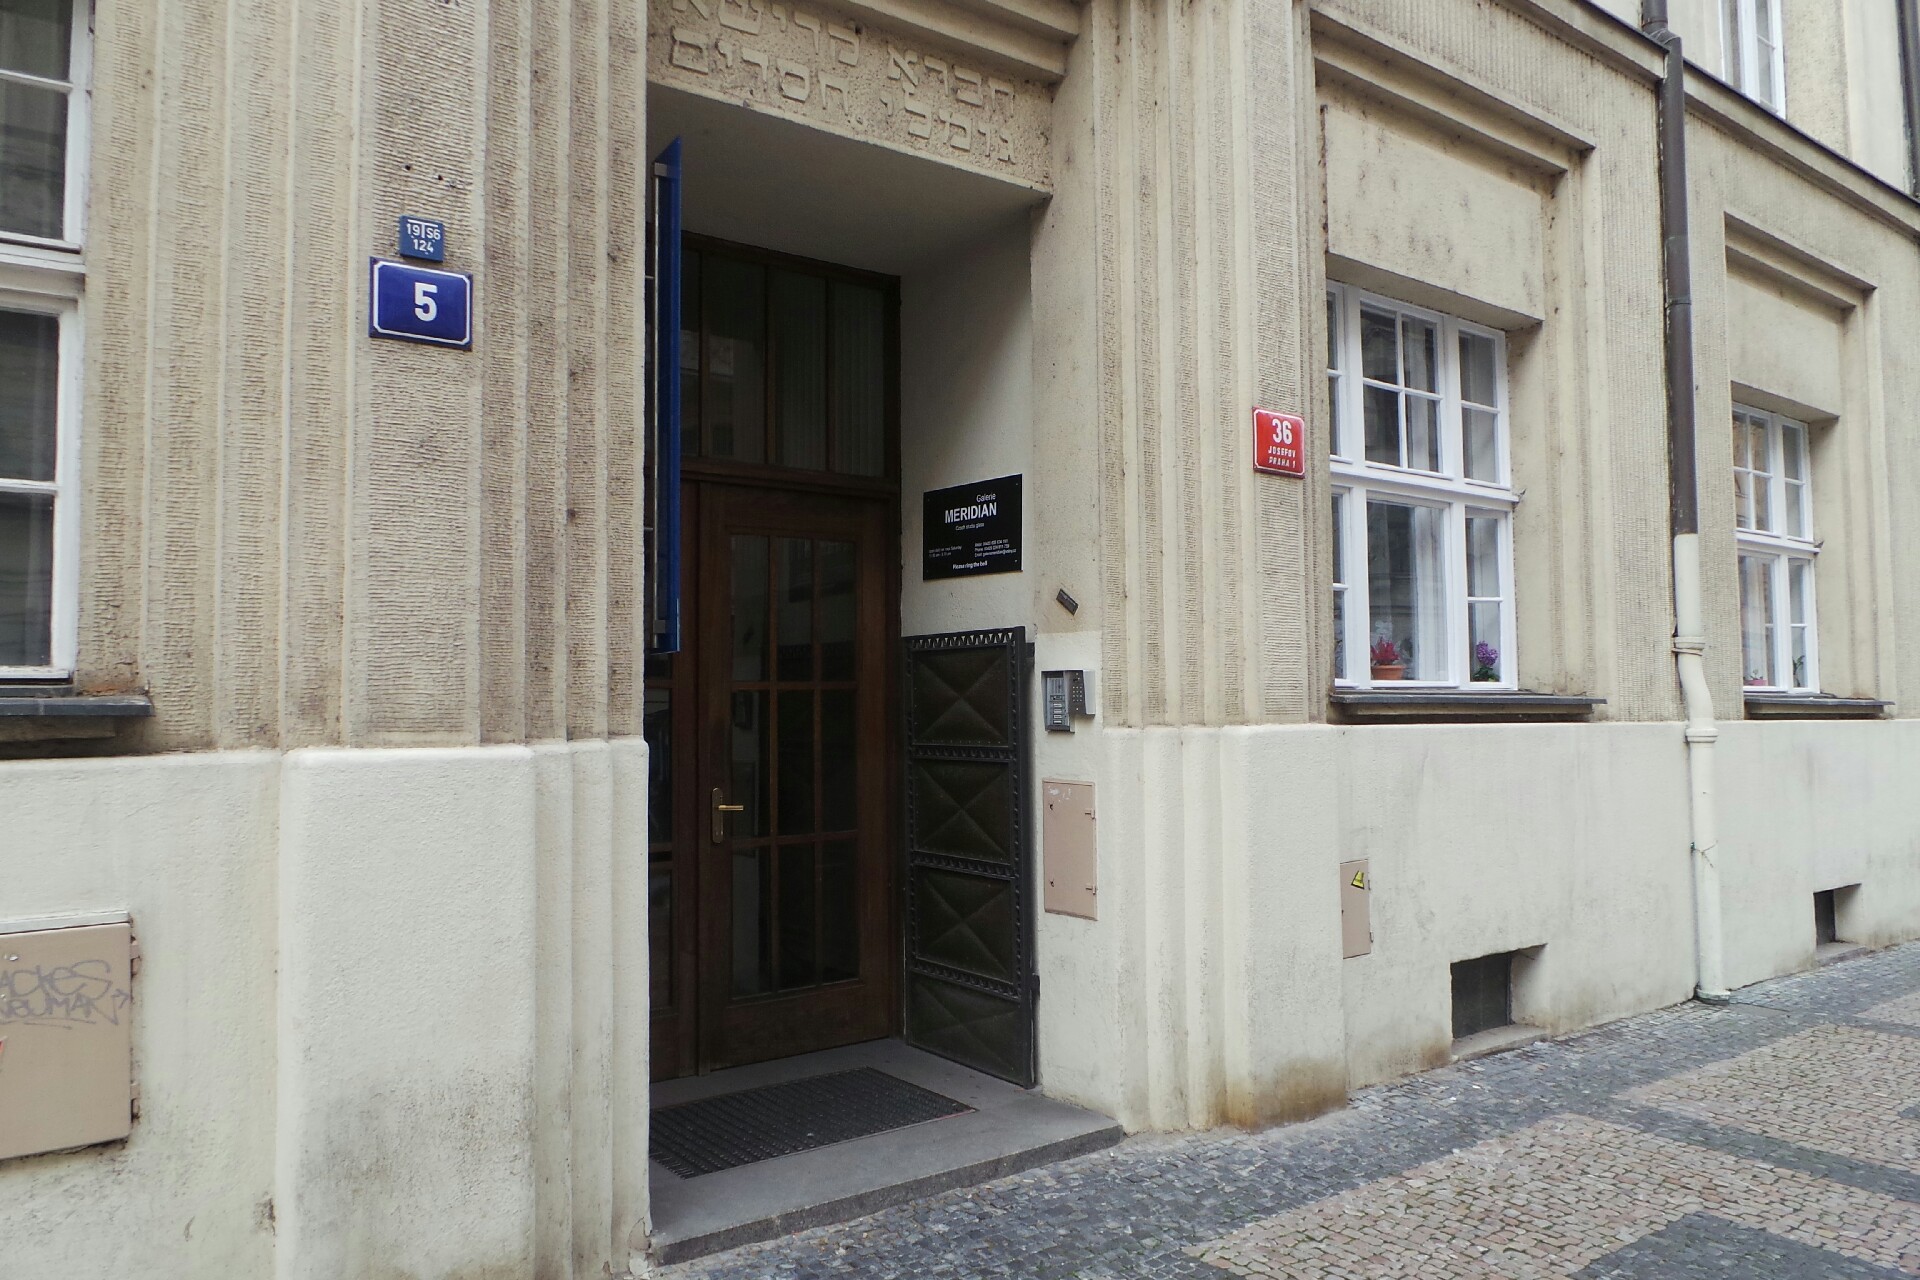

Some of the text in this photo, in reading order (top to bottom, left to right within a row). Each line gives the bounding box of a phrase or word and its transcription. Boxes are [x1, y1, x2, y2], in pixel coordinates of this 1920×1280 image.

[670, 25, 850, 116] חסדים
[413, 238, 434, 253] 124
[414, 281, 438, 322] 5
[1272, 418, 1293, 445] 36
[1268, 445, 1296, 458] JOSEFOV
[1268, 456, 1290, 467] PRAHA
[976, 493, 996, 503] Galerie
[944, 502, 997, 524] MERIDIAN
